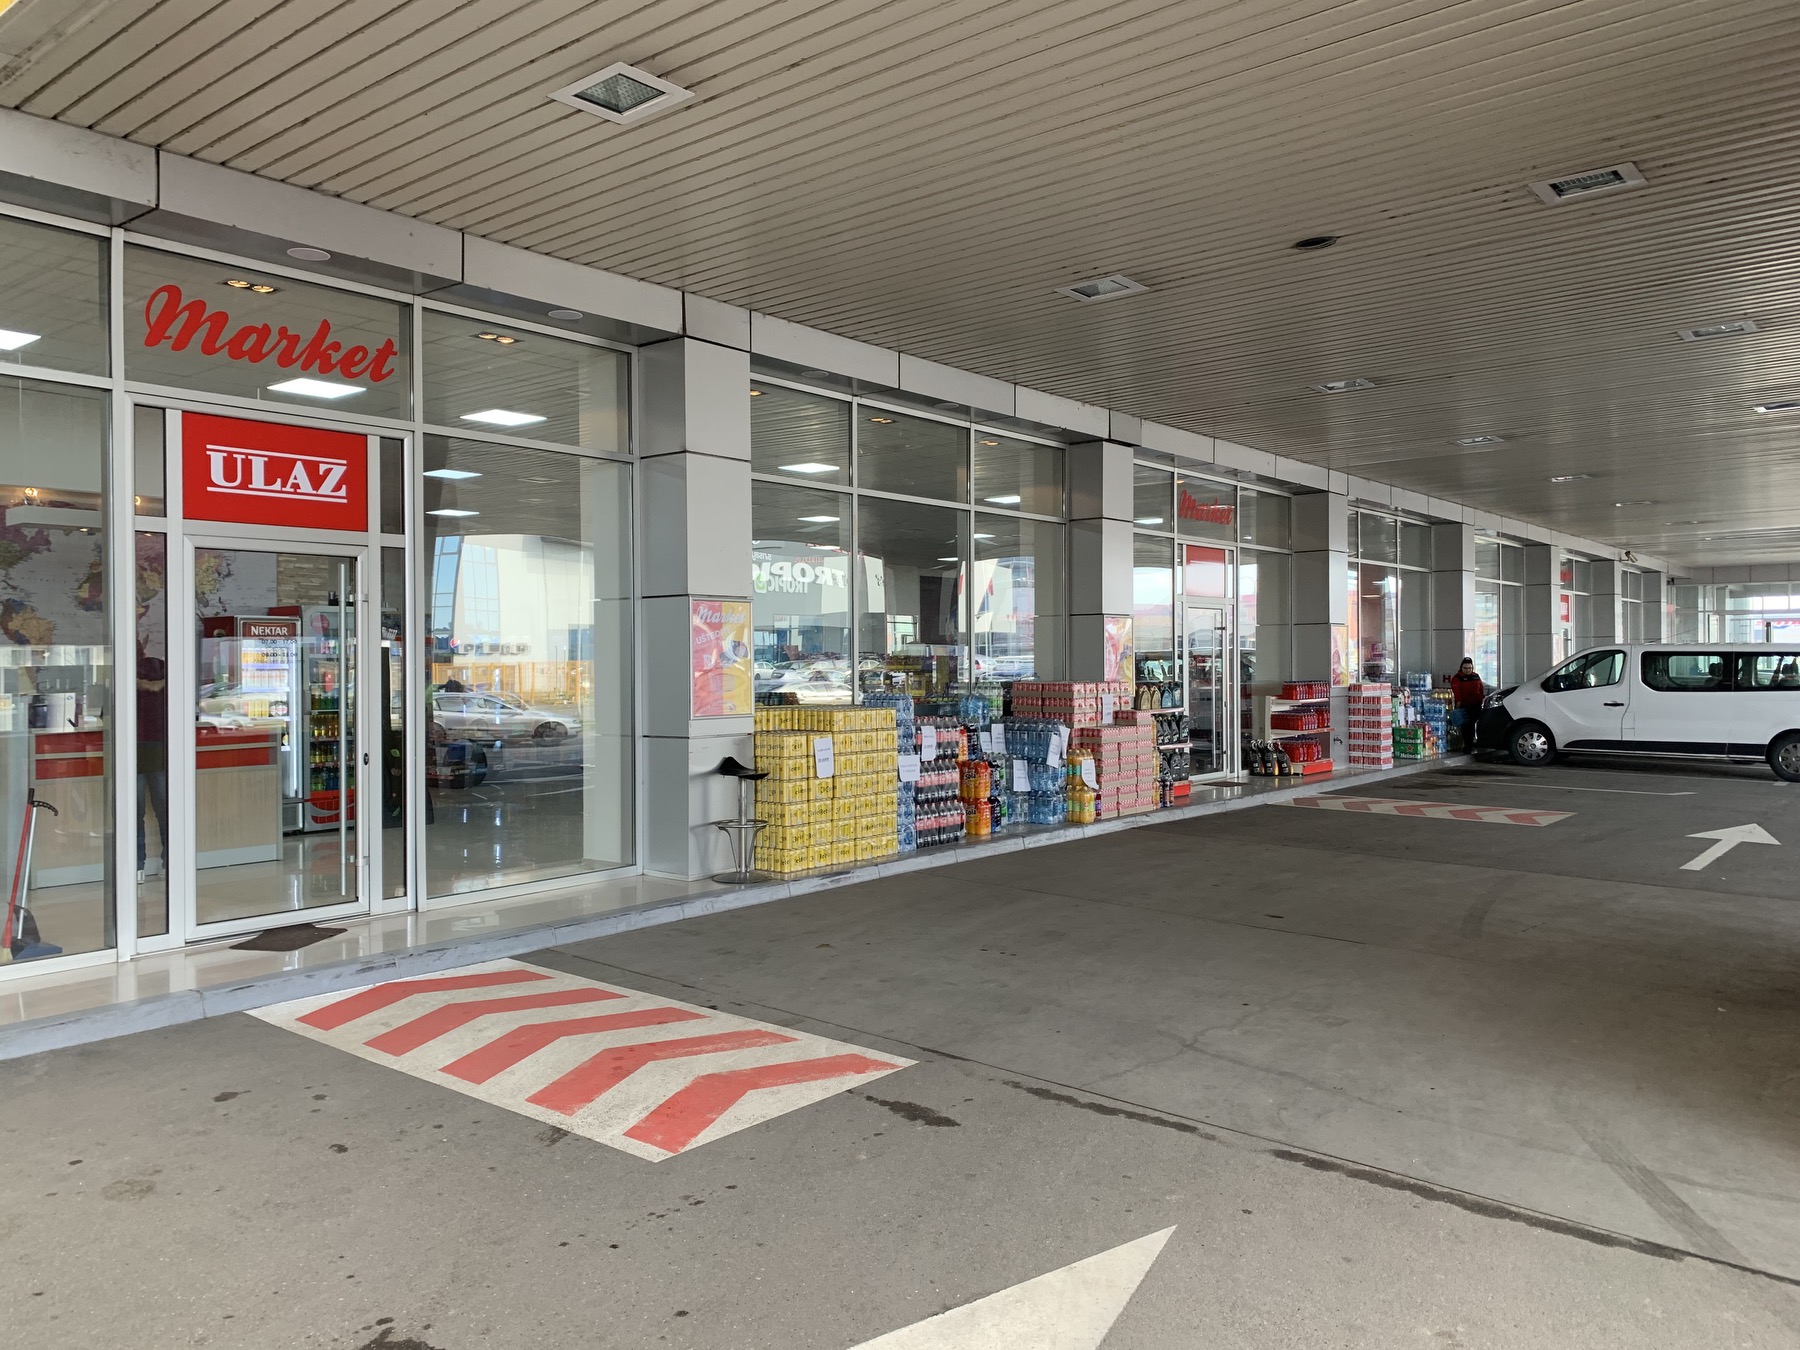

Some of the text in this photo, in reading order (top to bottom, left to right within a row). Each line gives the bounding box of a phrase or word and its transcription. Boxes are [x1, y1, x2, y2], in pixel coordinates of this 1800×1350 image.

[144, 284, 399, 382] Market
[207, 451, 347, 496] ULAZ
[1179, 489, 1233, 525] Market
[251, 626, 288, 636] NEKTAR
[697, 605, 746, 624] Market
